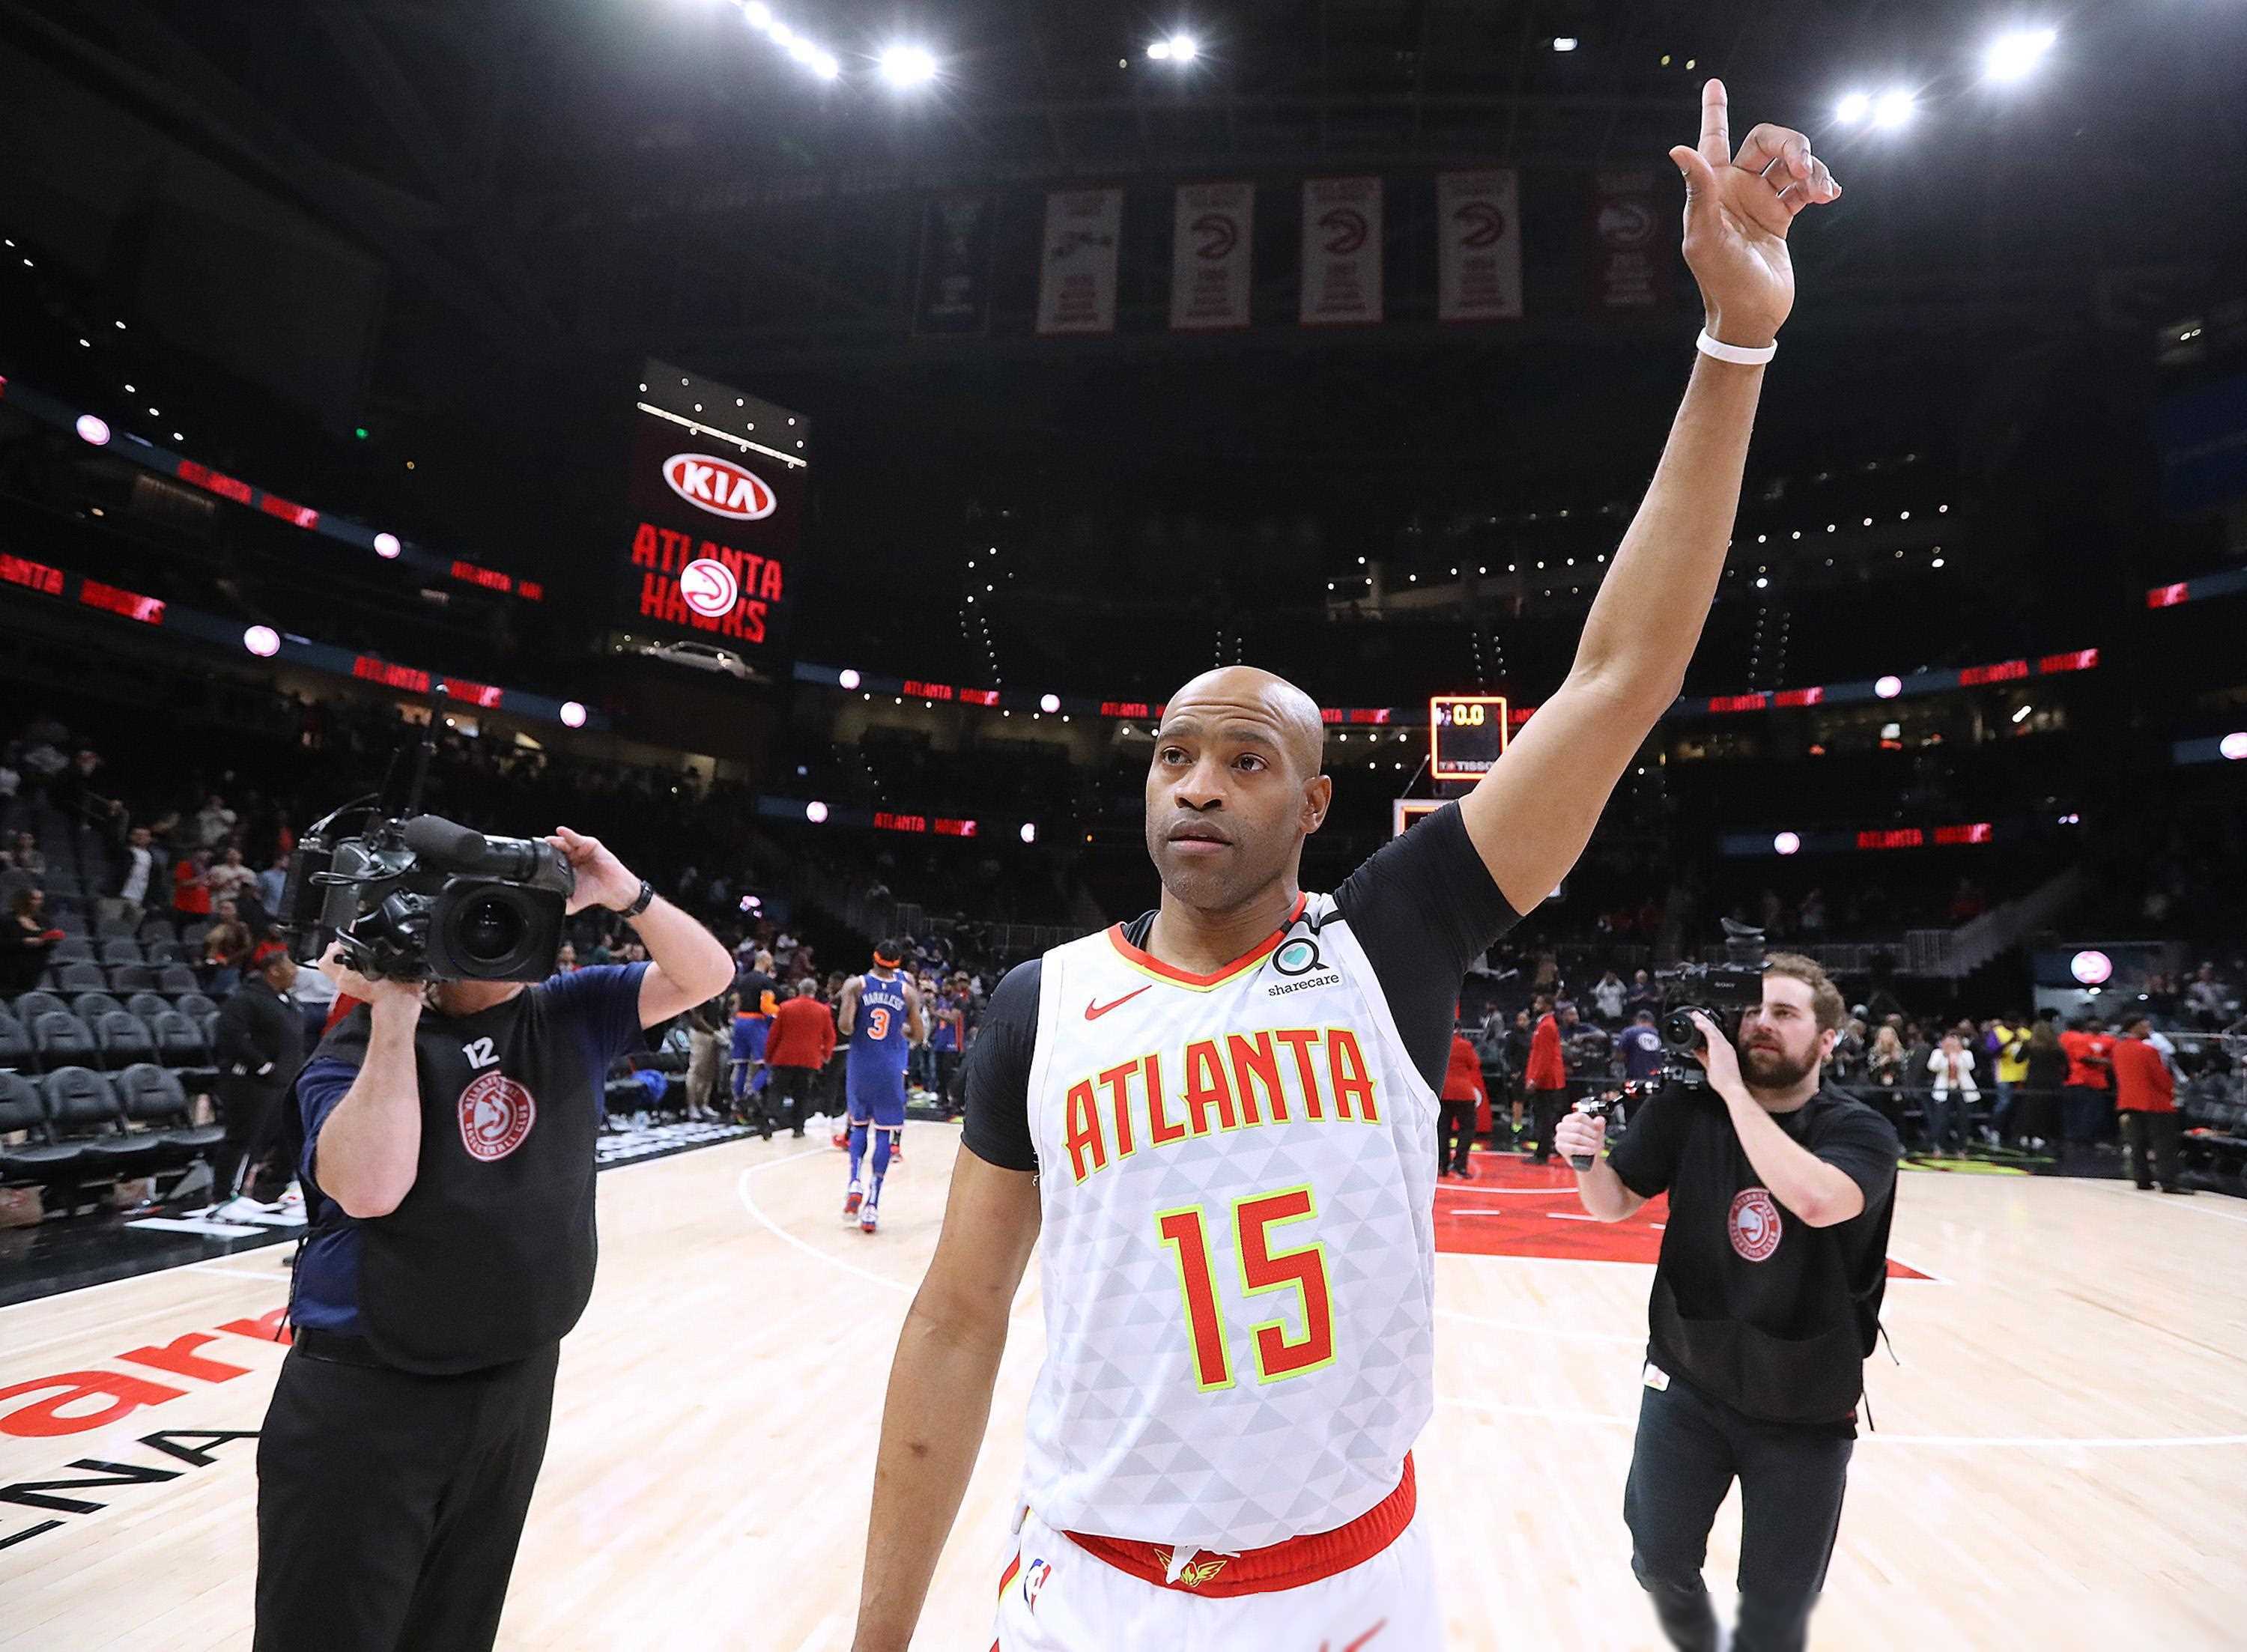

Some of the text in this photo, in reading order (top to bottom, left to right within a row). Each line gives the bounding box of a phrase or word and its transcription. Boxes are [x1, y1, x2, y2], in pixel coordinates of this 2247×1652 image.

[682, 461, 758, 514] KIA
[1452, 704, 1485, 726] 0.0
[1268, 974, 1340, 997] sharecare
[867, 1007, 891, 1040] 3
[462, 1036, 500, 1069] 12
[1061, 1027, 1381, 1185] ATLANTA
[1153, 1183, 1336, 1393] 15
